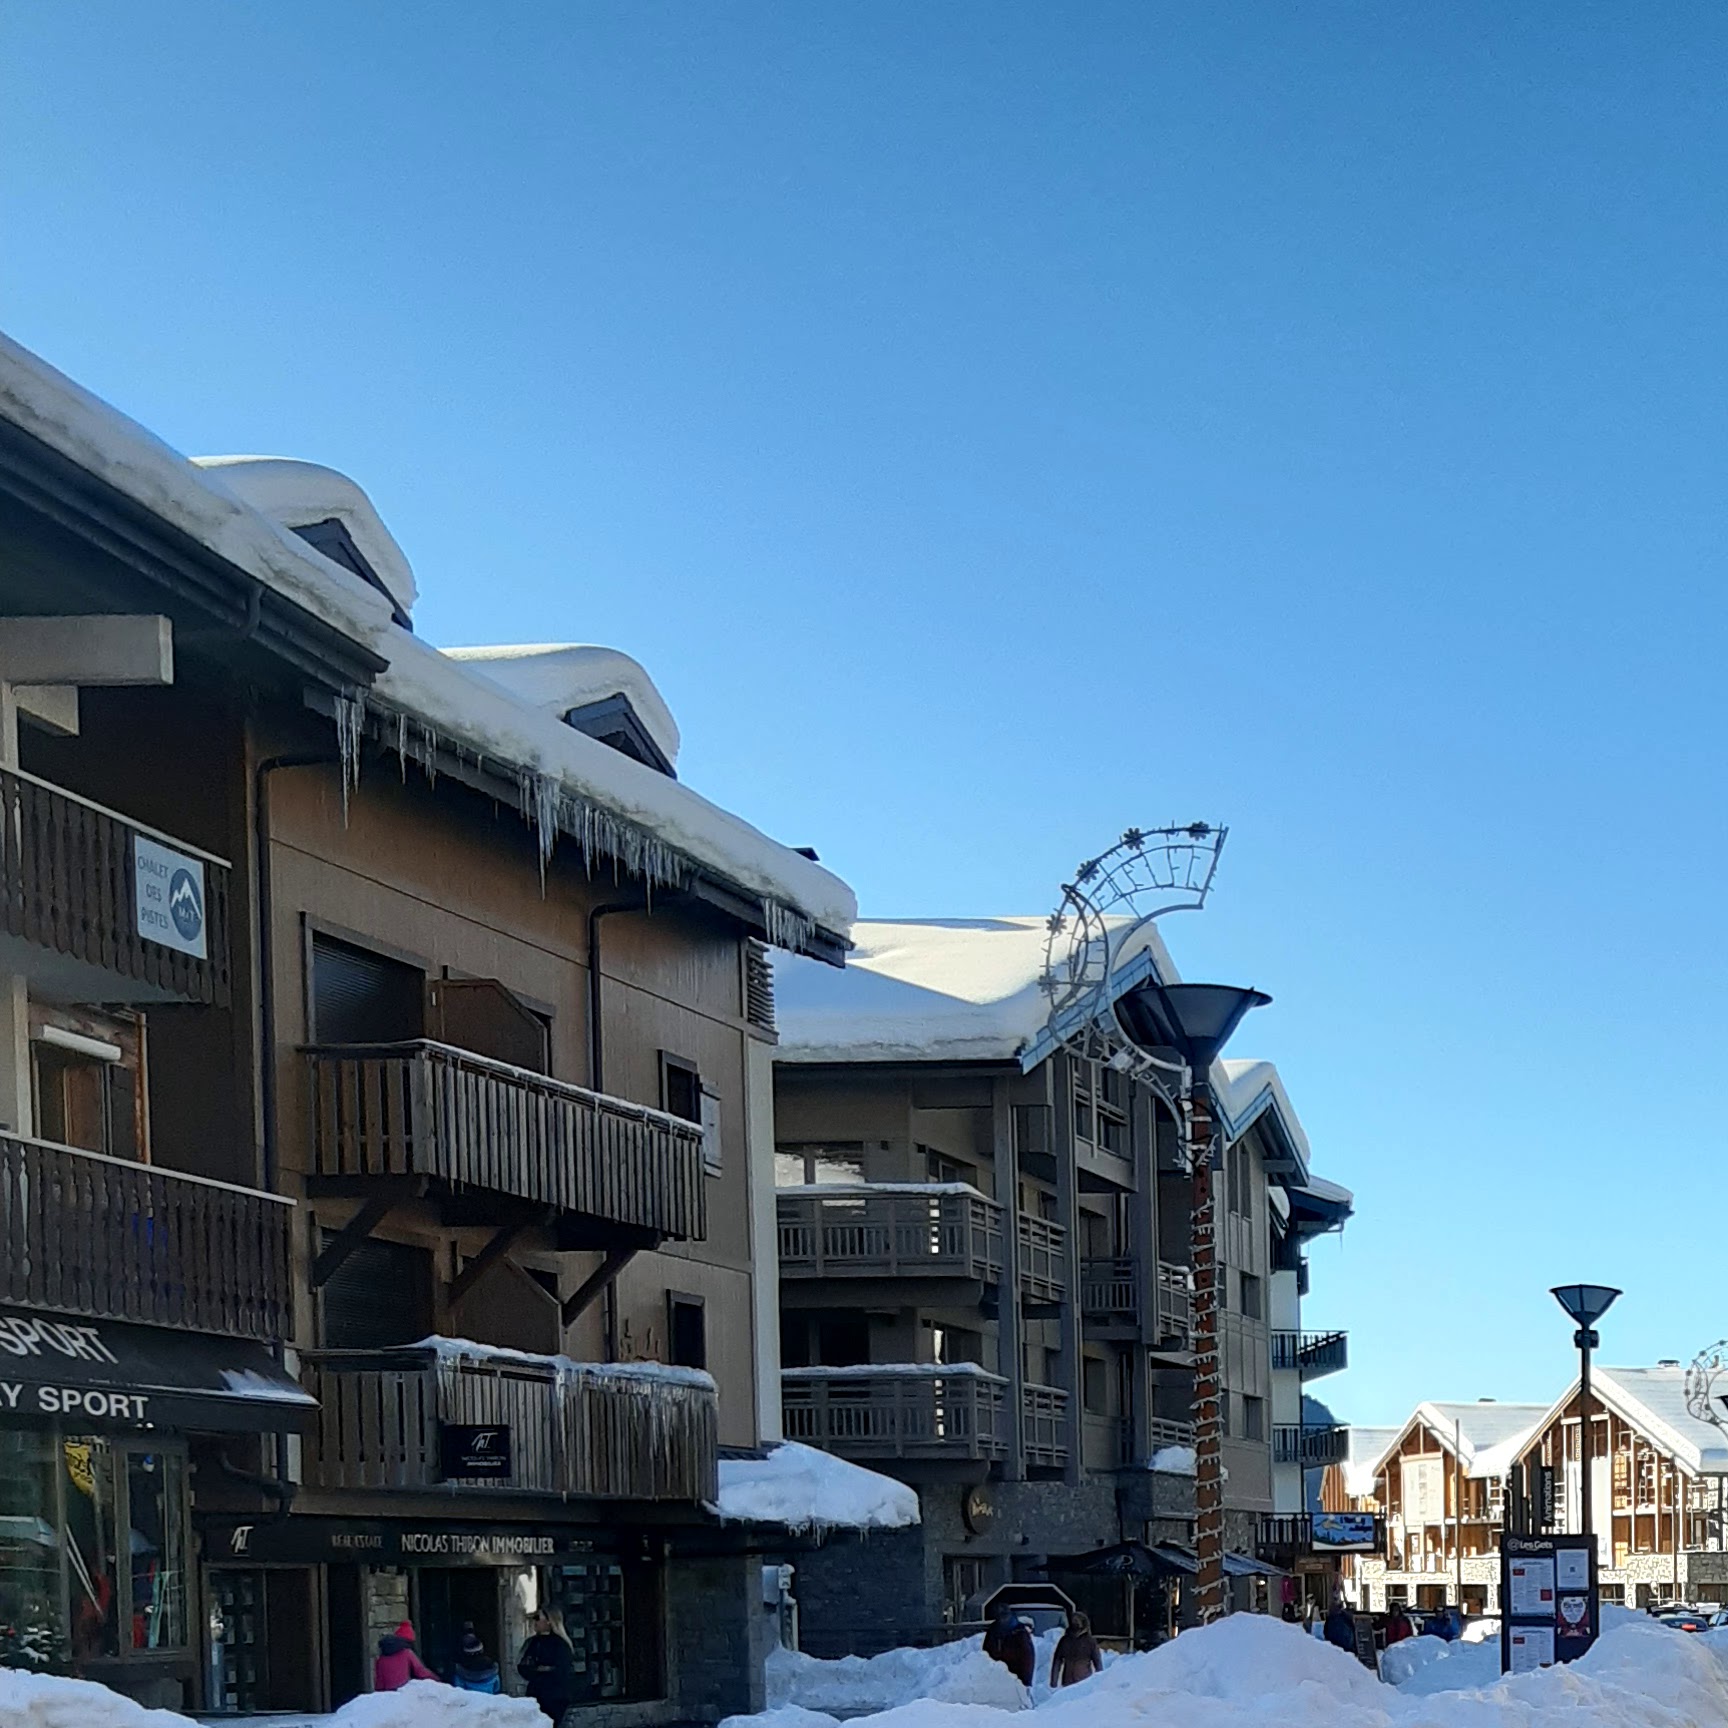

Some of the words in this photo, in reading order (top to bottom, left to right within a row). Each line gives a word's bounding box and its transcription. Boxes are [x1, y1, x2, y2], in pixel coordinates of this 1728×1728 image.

[0, 1316, 119, 1365] SPORT
[38, 1386, 150, 1419] SPORT
[401, 1534, 448, 1553] NICOLAS
